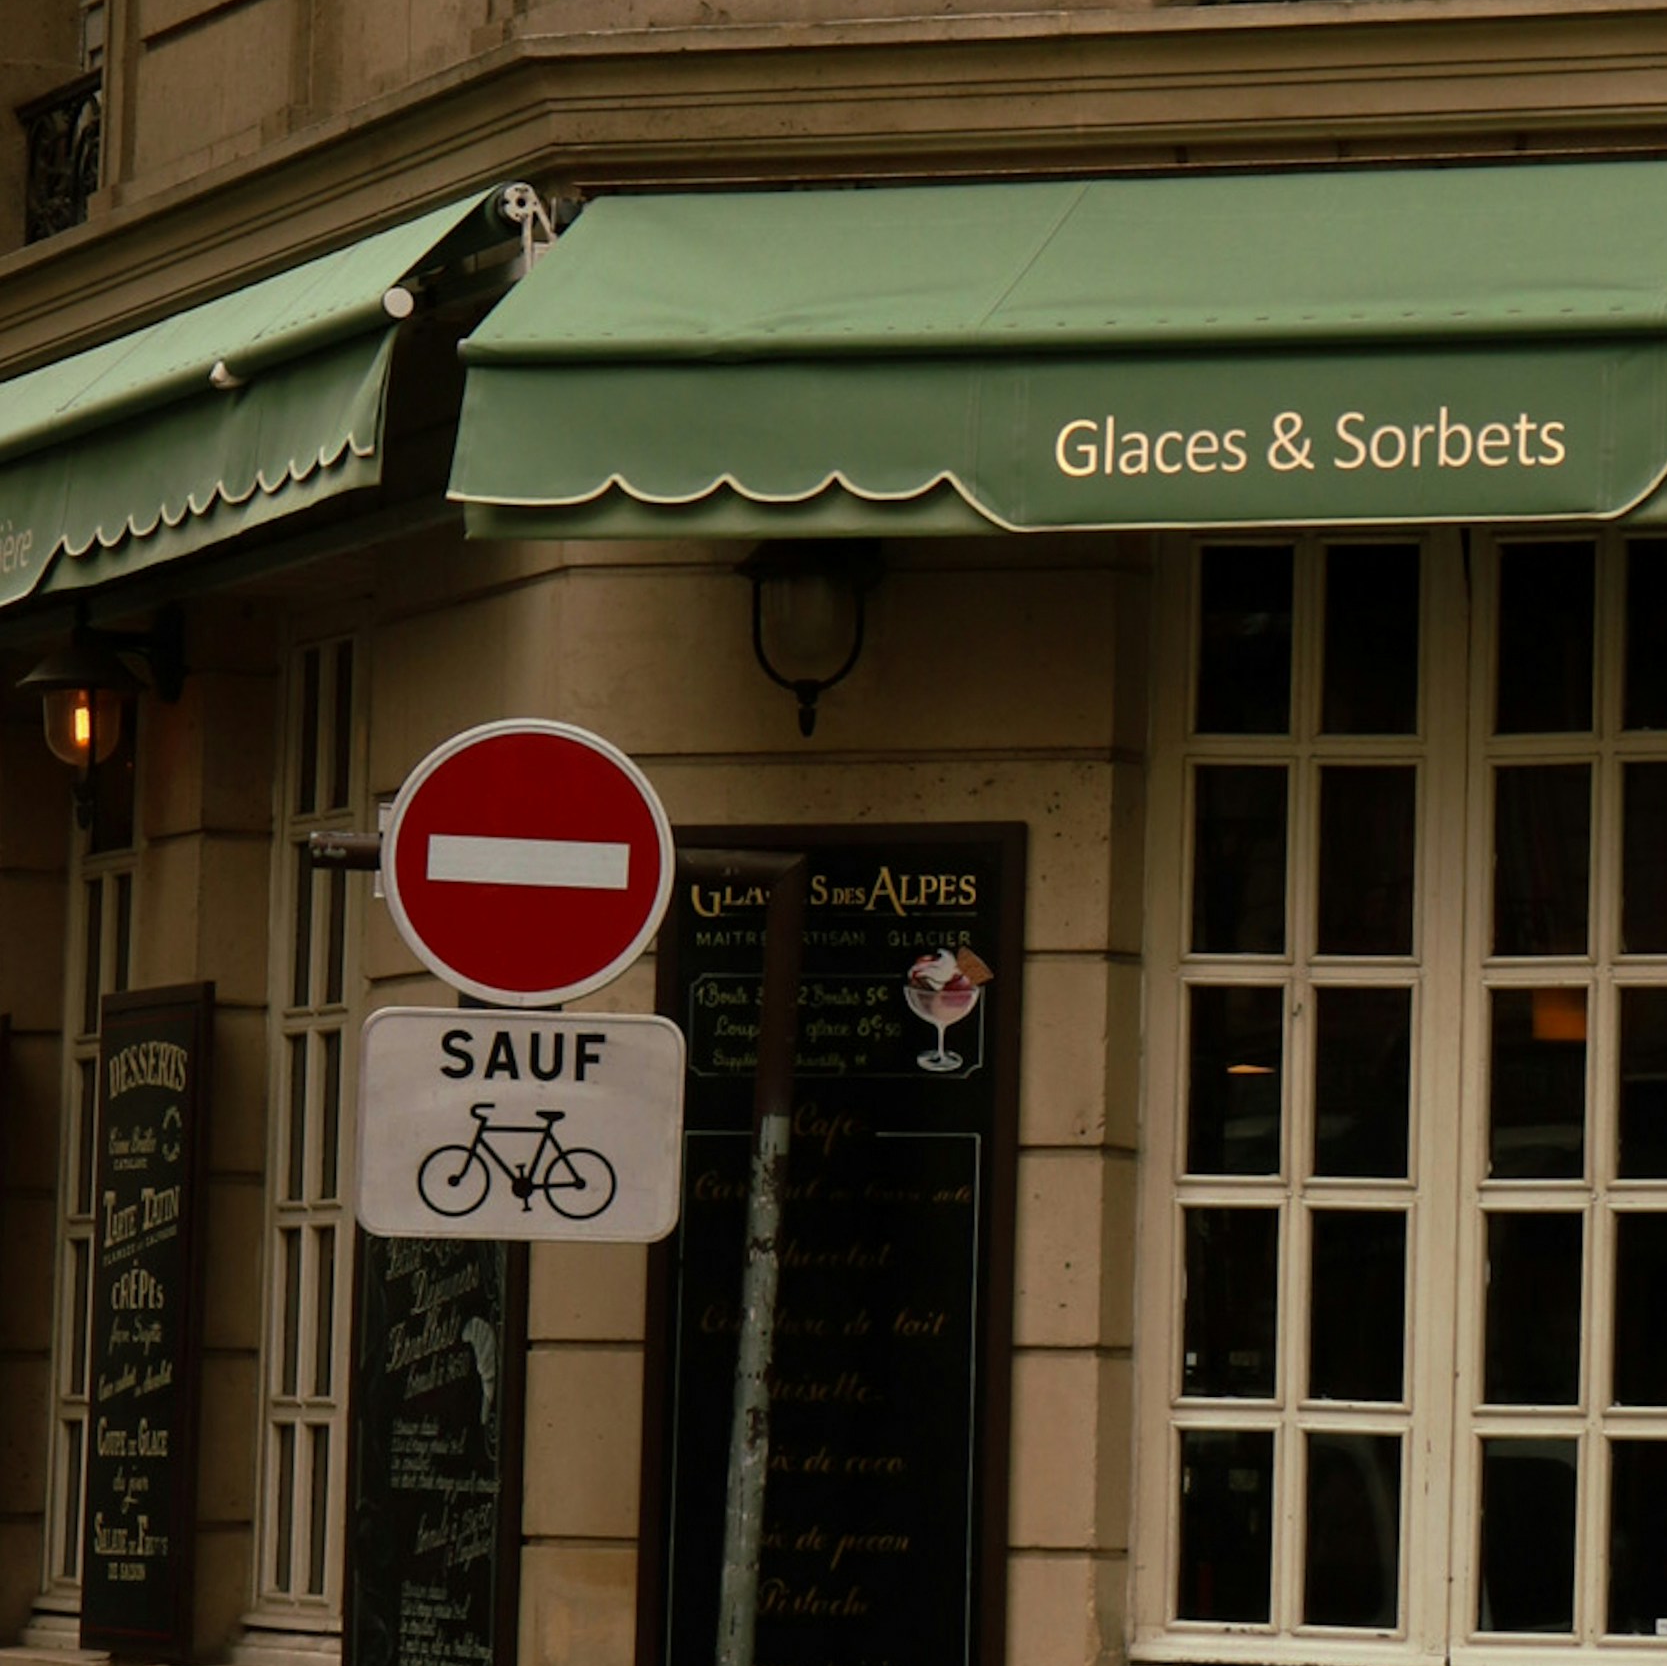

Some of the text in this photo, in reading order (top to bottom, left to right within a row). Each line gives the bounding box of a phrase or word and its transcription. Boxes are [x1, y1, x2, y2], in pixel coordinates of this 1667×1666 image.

[1054, 406, 1567, 477] Glaces & Sorbets
[832, 886, 867, 905] DES
[864, 866, 977, 917] ALPES
[803, 931, 866, 947] RTISAN
[888, 930, 971, 947] GLACIER
[109, 1040, 188, 1100] DESSERTS
[441, 1031, 605, 1081] SAUF
